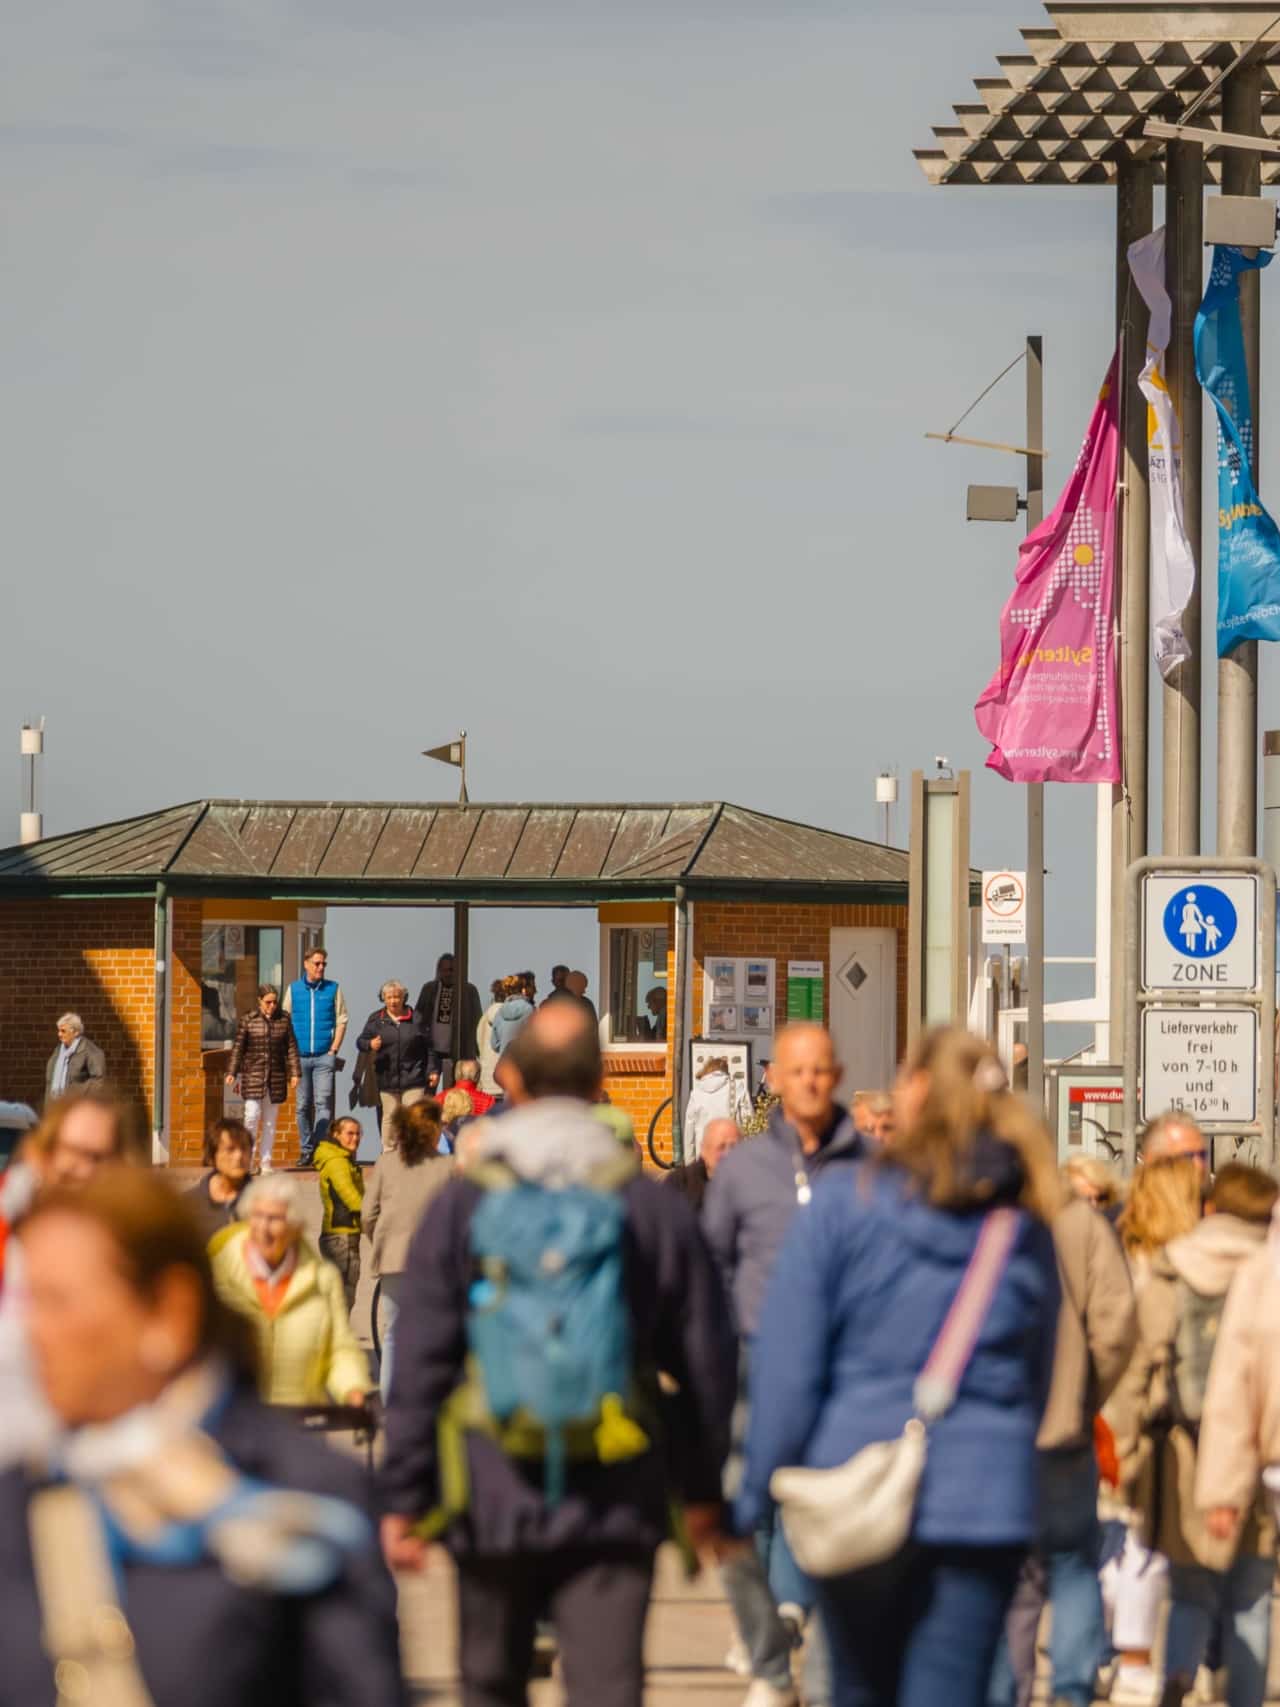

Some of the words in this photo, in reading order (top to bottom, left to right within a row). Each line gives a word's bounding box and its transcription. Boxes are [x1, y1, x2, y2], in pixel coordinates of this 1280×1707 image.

[1172, 963, 1228, 982] ZONE
[1160, 1020, 1238, 1035] Lieferverkehr
[1187, 1040, 1213, 1053] frei
[1162, 1062, 1189, 1073] von
[1196, 1059, 1227, 1073] 7-10
[1231, 1059, 1238, 1073] h
[1185, 1079, 1213, 1092] und
[1222, 1098, 1229, 1111] h
